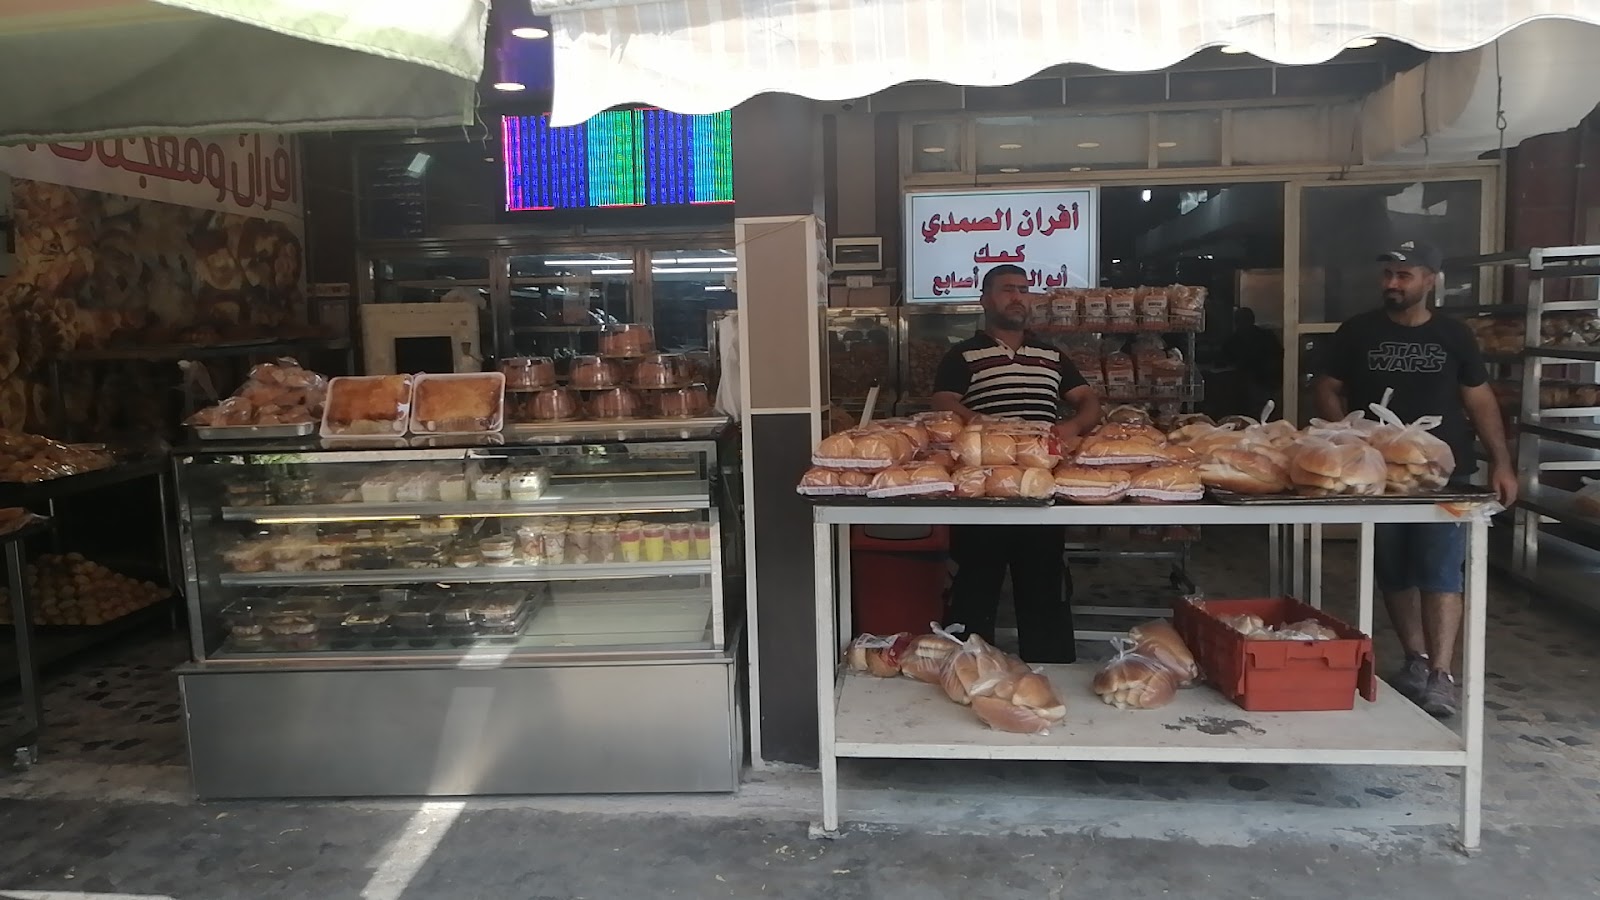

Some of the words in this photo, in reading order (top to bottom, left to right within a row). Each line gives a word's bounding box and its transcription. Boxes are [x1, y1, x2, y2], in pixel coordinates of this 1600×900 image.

[921, 207, 1012, 243] الصمدي
[1016, 201, 1079, 237] أفران
[973, 243, 1026, 263] كعك
[932, 265, 979, 296] أصابع
[1369, 341, 1447, 357] STAR
[1368, 355, 1447, 373] WARS
